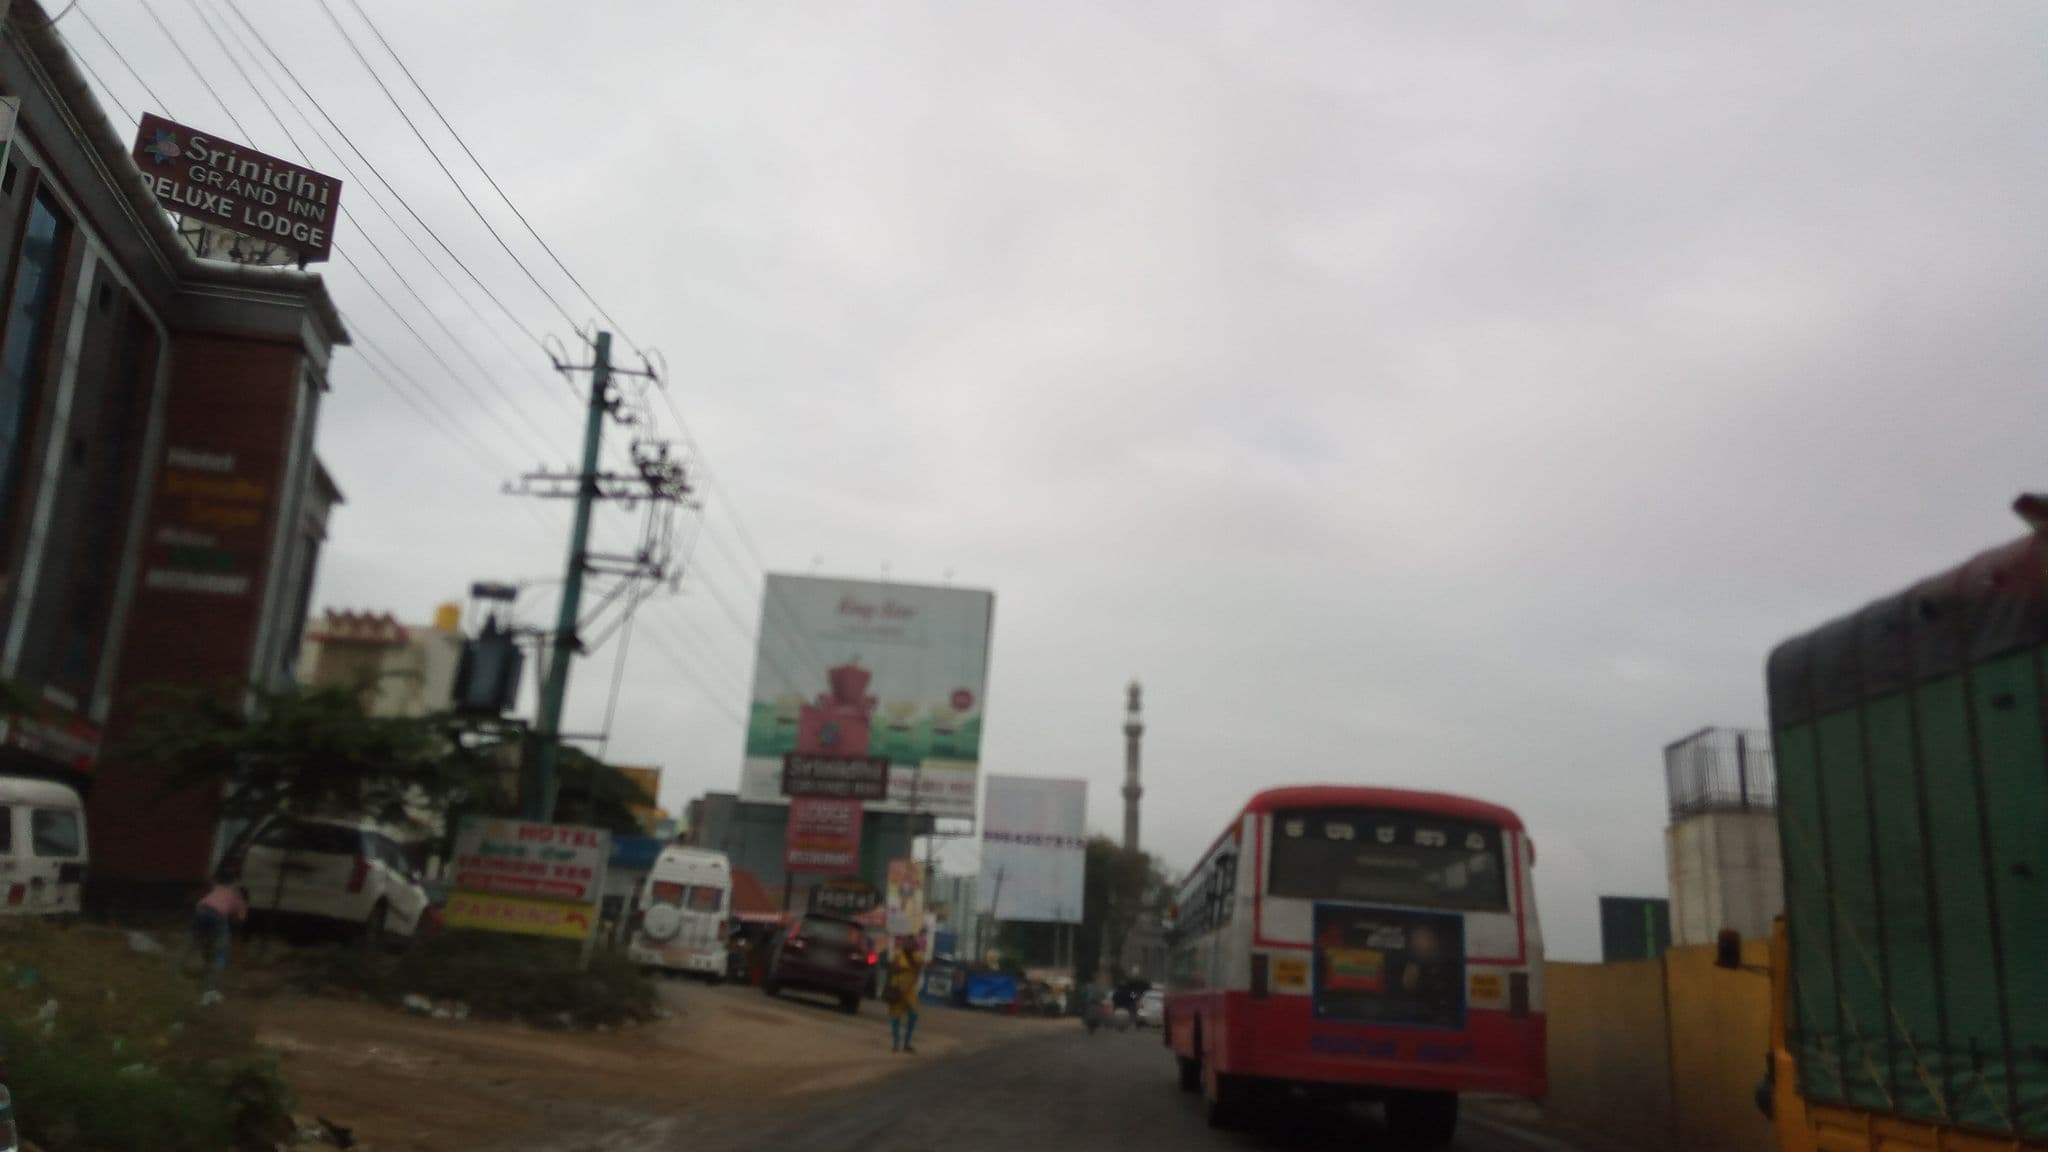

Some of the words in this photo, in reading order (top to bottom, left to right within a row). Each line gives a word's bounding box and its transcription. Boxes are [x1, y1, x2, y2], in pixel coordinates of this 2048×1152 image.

[184, 136, 330, 206] Srinidhi
[188, 165, 277, 206] GRAND
[287, 198, 326, 223] INN
[141, 172, 235, 219] DELUXE
[243, 207, 325, 249] LODGE
[519, 824, 598, 848] HOTEL
